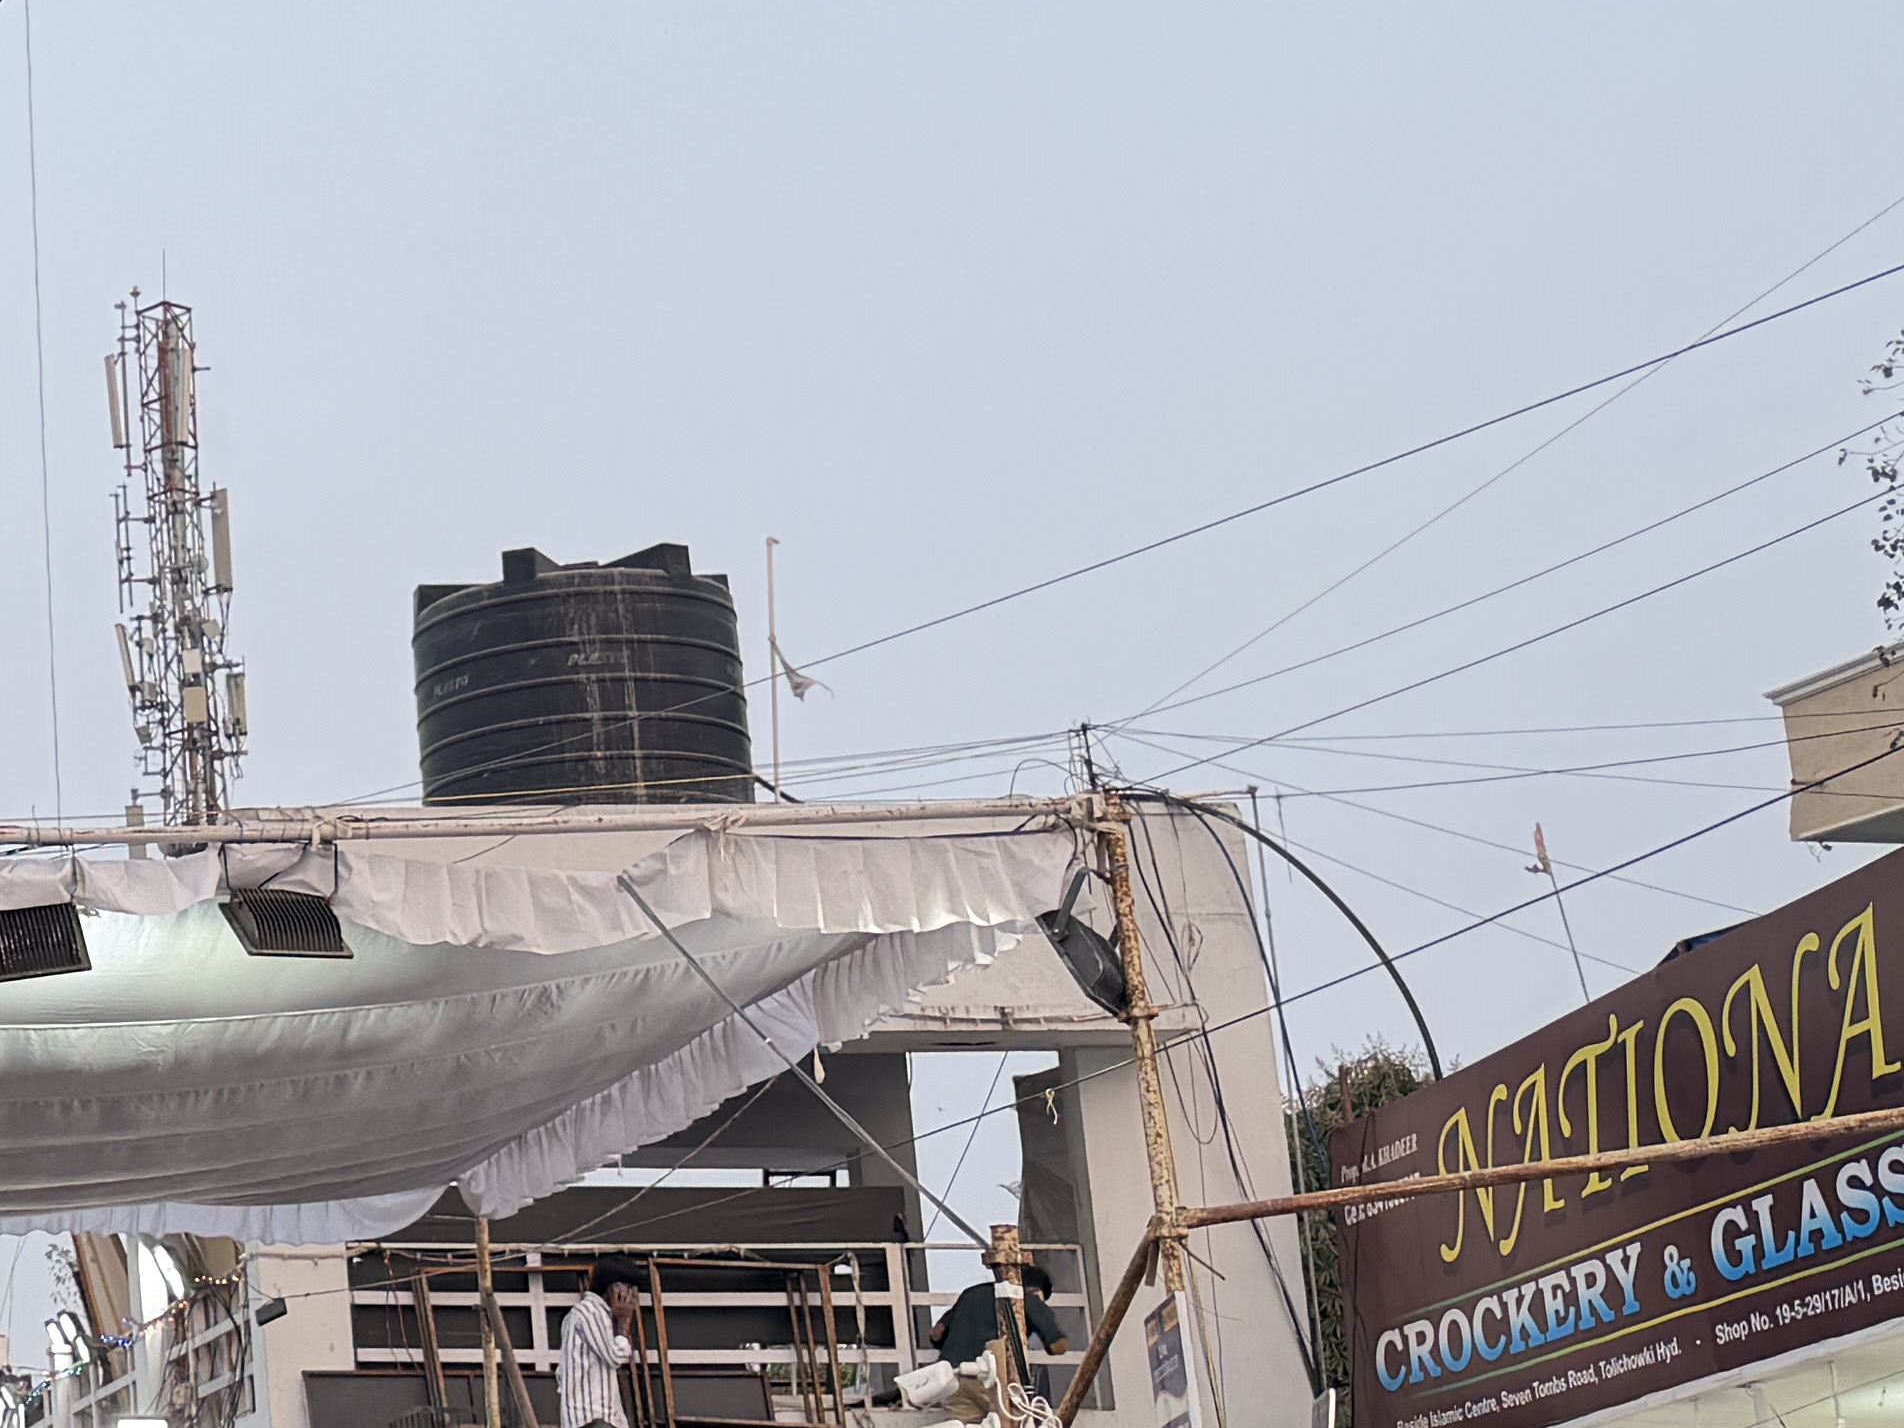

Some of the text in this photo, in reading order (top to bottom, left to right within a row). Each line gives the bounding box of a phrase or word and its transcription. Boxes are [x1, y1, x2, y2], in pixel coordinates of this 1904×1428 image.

[1378, 1133, 1418, 1167] KHADEER
[1375, 1240, 1642, 1392] CROCKERY
[1664, 1244, 1697, 1298] &
[1715, 1320, 1750, 1345] Shop
[1750, 1311, 1774, 1333] No.
[1872, 1267, 1904, 1296] Besi
[1429, 1407, 1464, 1428] Islamic
[1465, 1394, 1501, 1419] Centre,
[1502, 1387, 1532, 1409] Seven
[1533, 1375, 1567, 1398] Tombs
[1568, 1366, 1599, 1389] Road,
[1656, 1337, 1683, 1365] Hyd.
